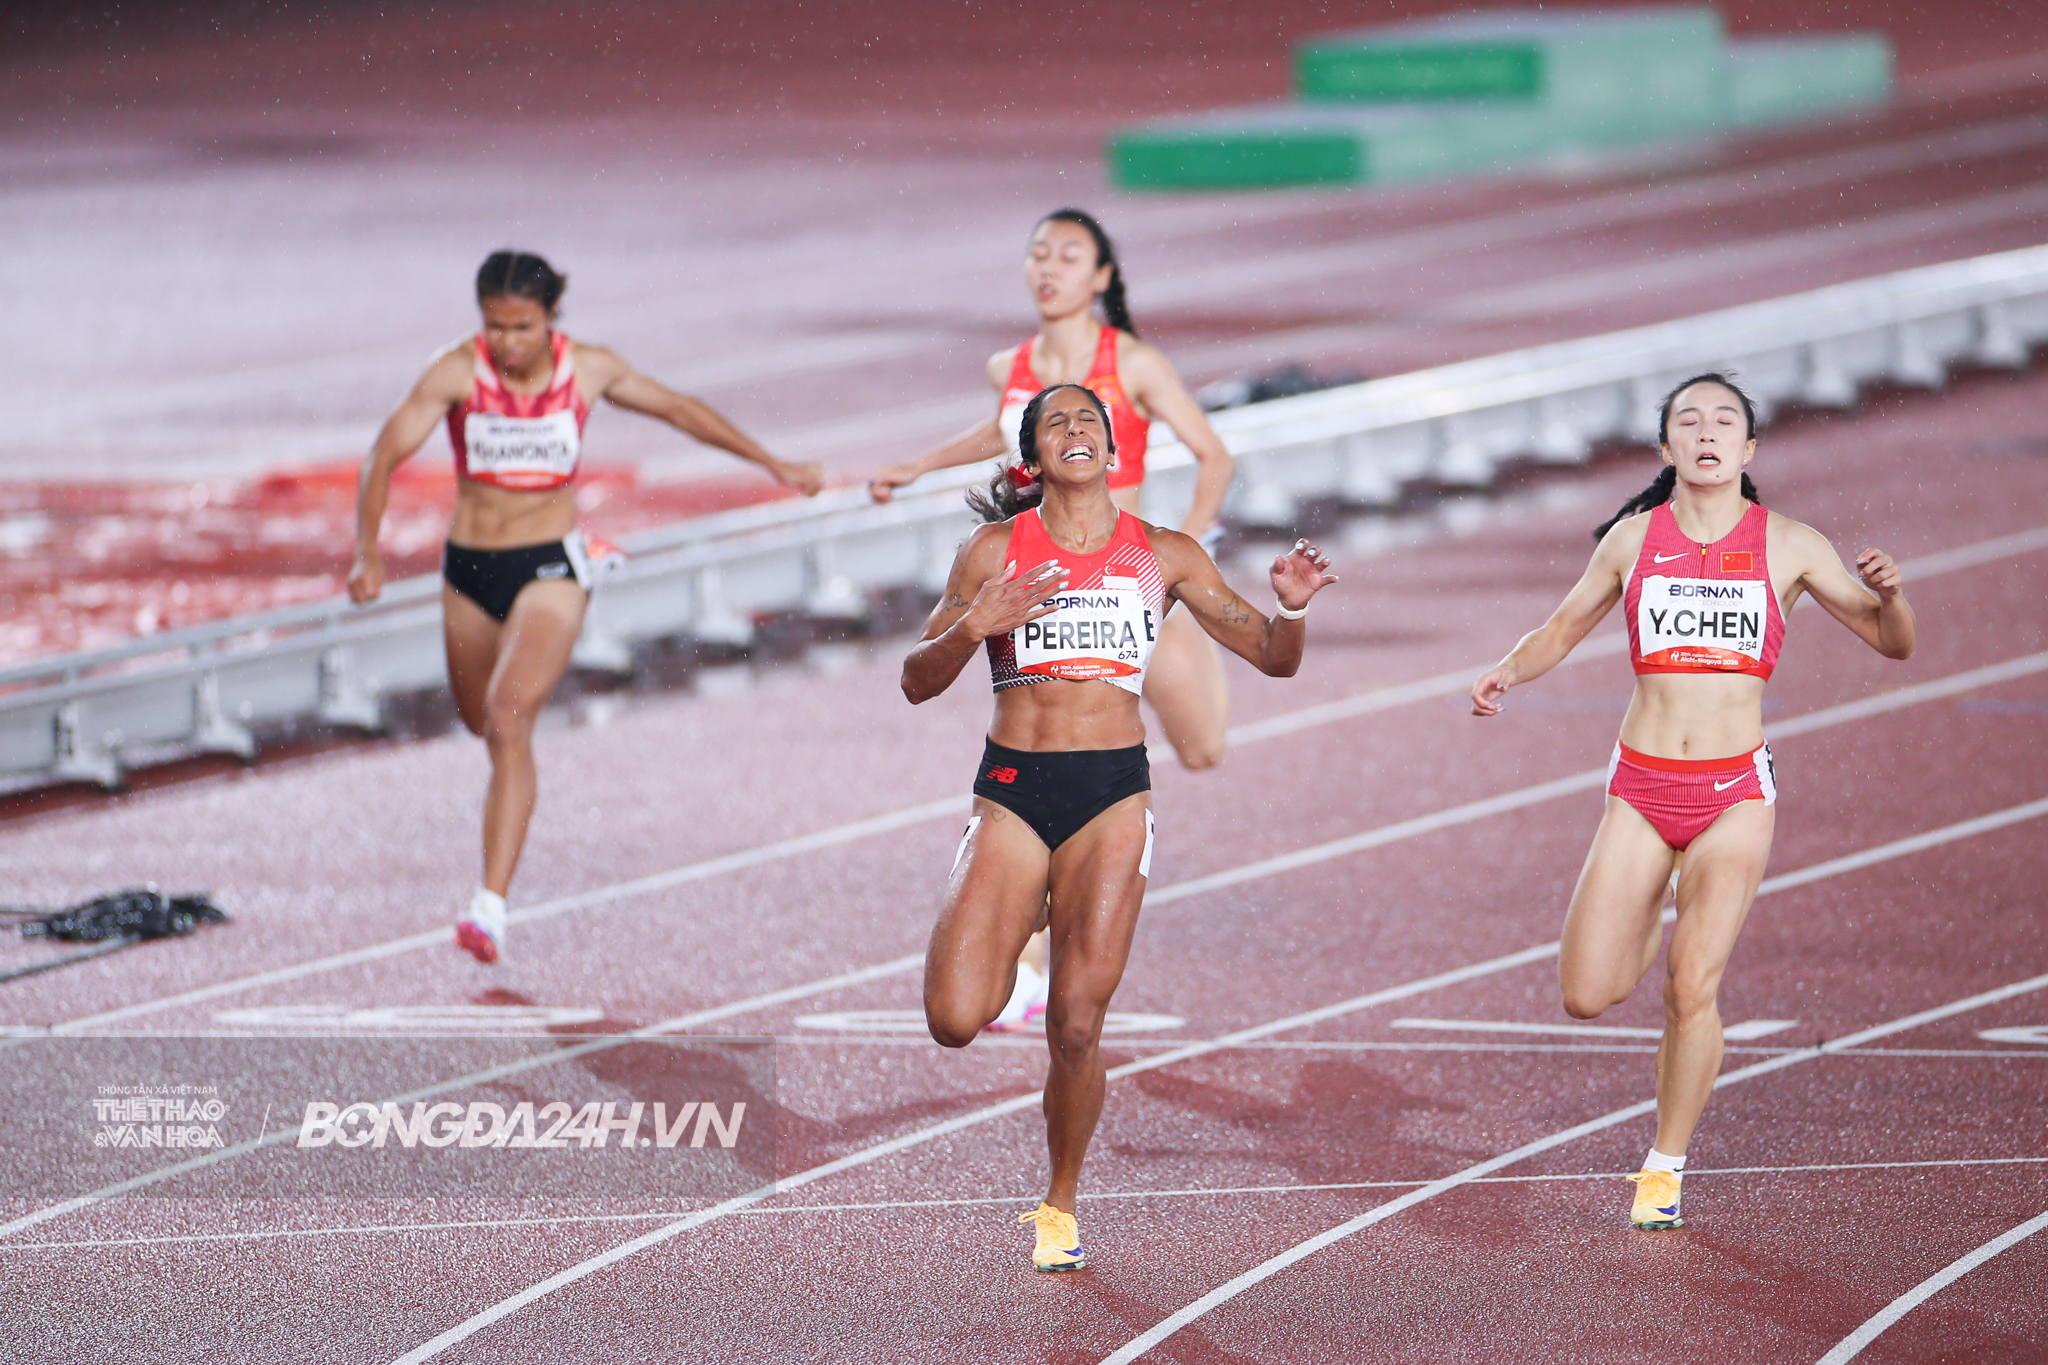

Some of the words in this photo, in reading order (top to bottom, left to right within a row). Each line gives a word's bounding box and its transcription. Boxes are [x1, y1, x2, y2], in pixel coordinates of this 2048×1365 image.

[1668, 584, 1743, 599] BORNAN
[1648, 607, 1759, 638] Y.CHEN
[1025, 620, 1138, 650] PEREIRA
[1738, 641, 1757, 651] 254
[1118, 650, 1139, 660] 674
